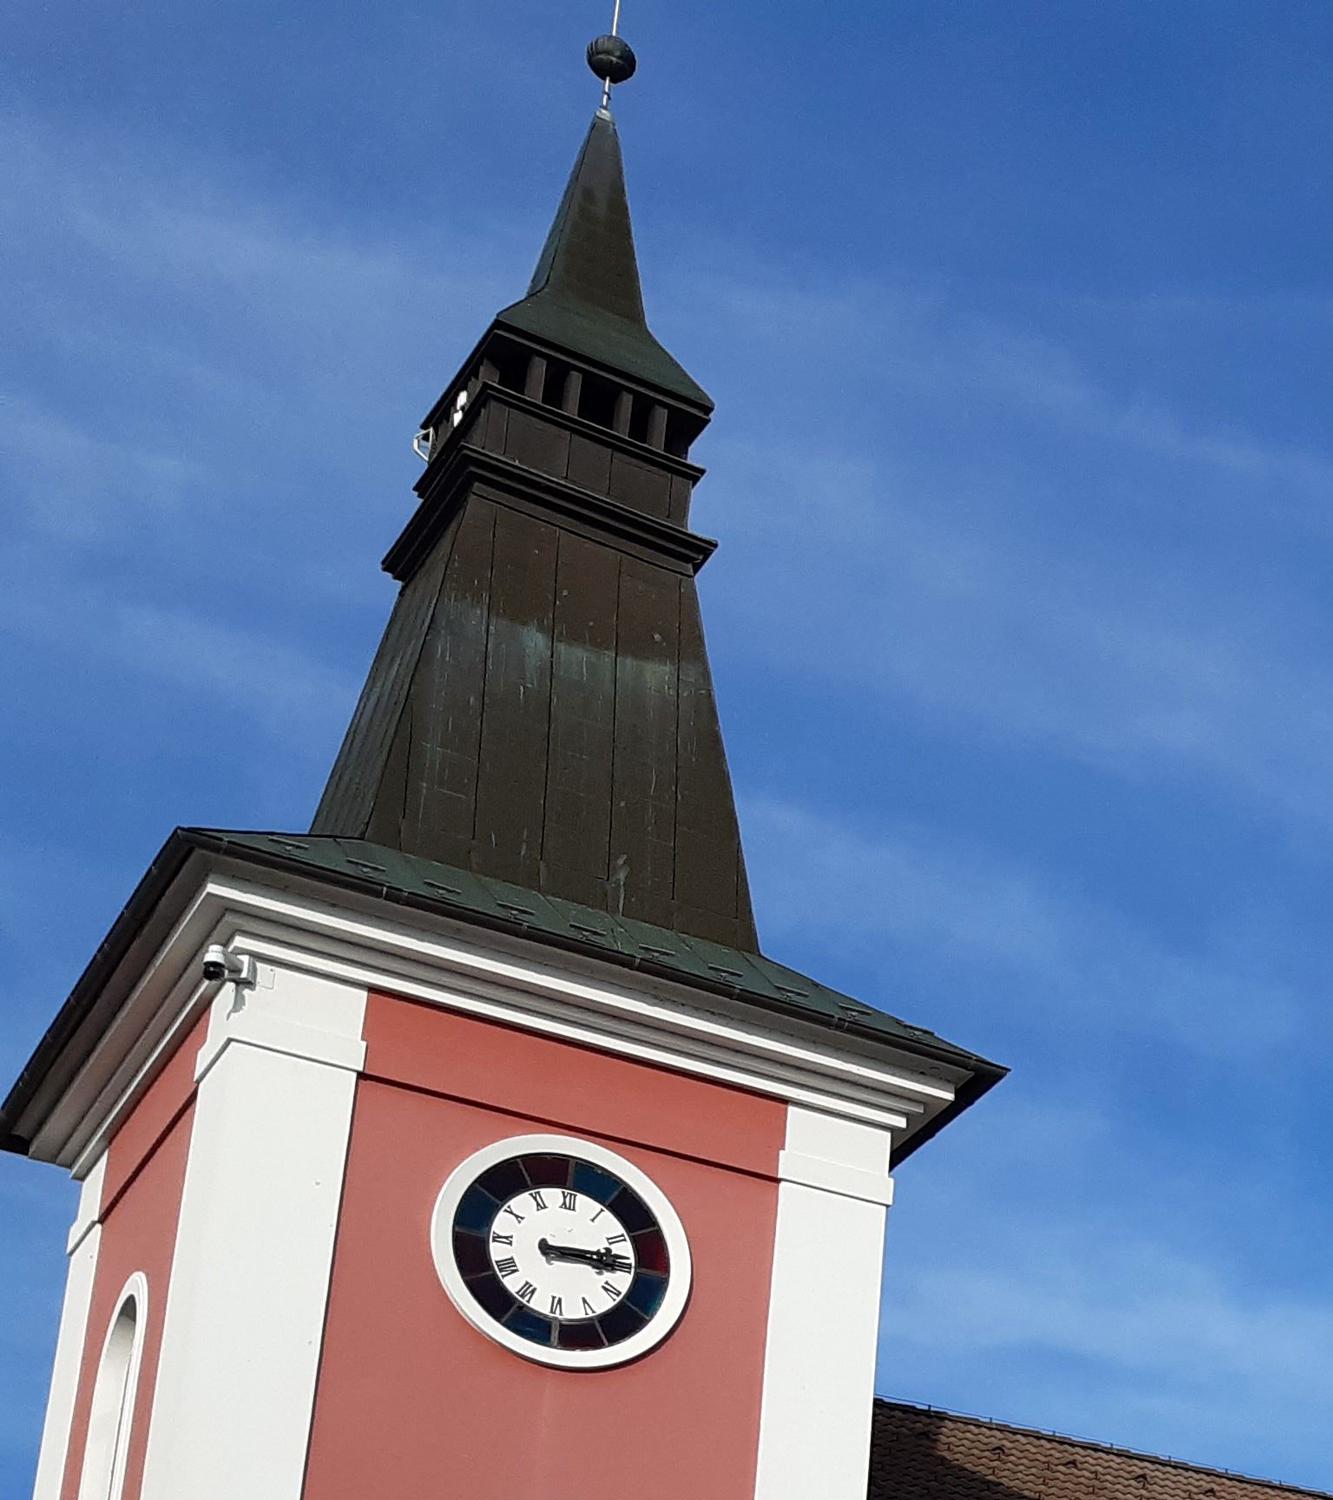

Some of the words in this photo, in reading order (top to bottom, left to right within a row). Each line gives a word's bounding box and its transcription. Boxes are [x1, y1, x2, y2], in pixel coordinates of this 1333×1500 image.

[528, 1190, 549, 1212] XI
[559, 1190, 578, 1212] XII
[502, 1204, 526, 1224] X
[589, 1207, 605, 1223] I
[491, 1231, 514, 1247] IX
[605, 1233, 627, 1246] II
[494, 1255, 520, 1279] VIII
[514, 1279, 538, 1304] VII
[600, 1280, 622, 1302] IV
[548, 1295, 564, 1317] VI
[581, 1296, 597, 1316] V
